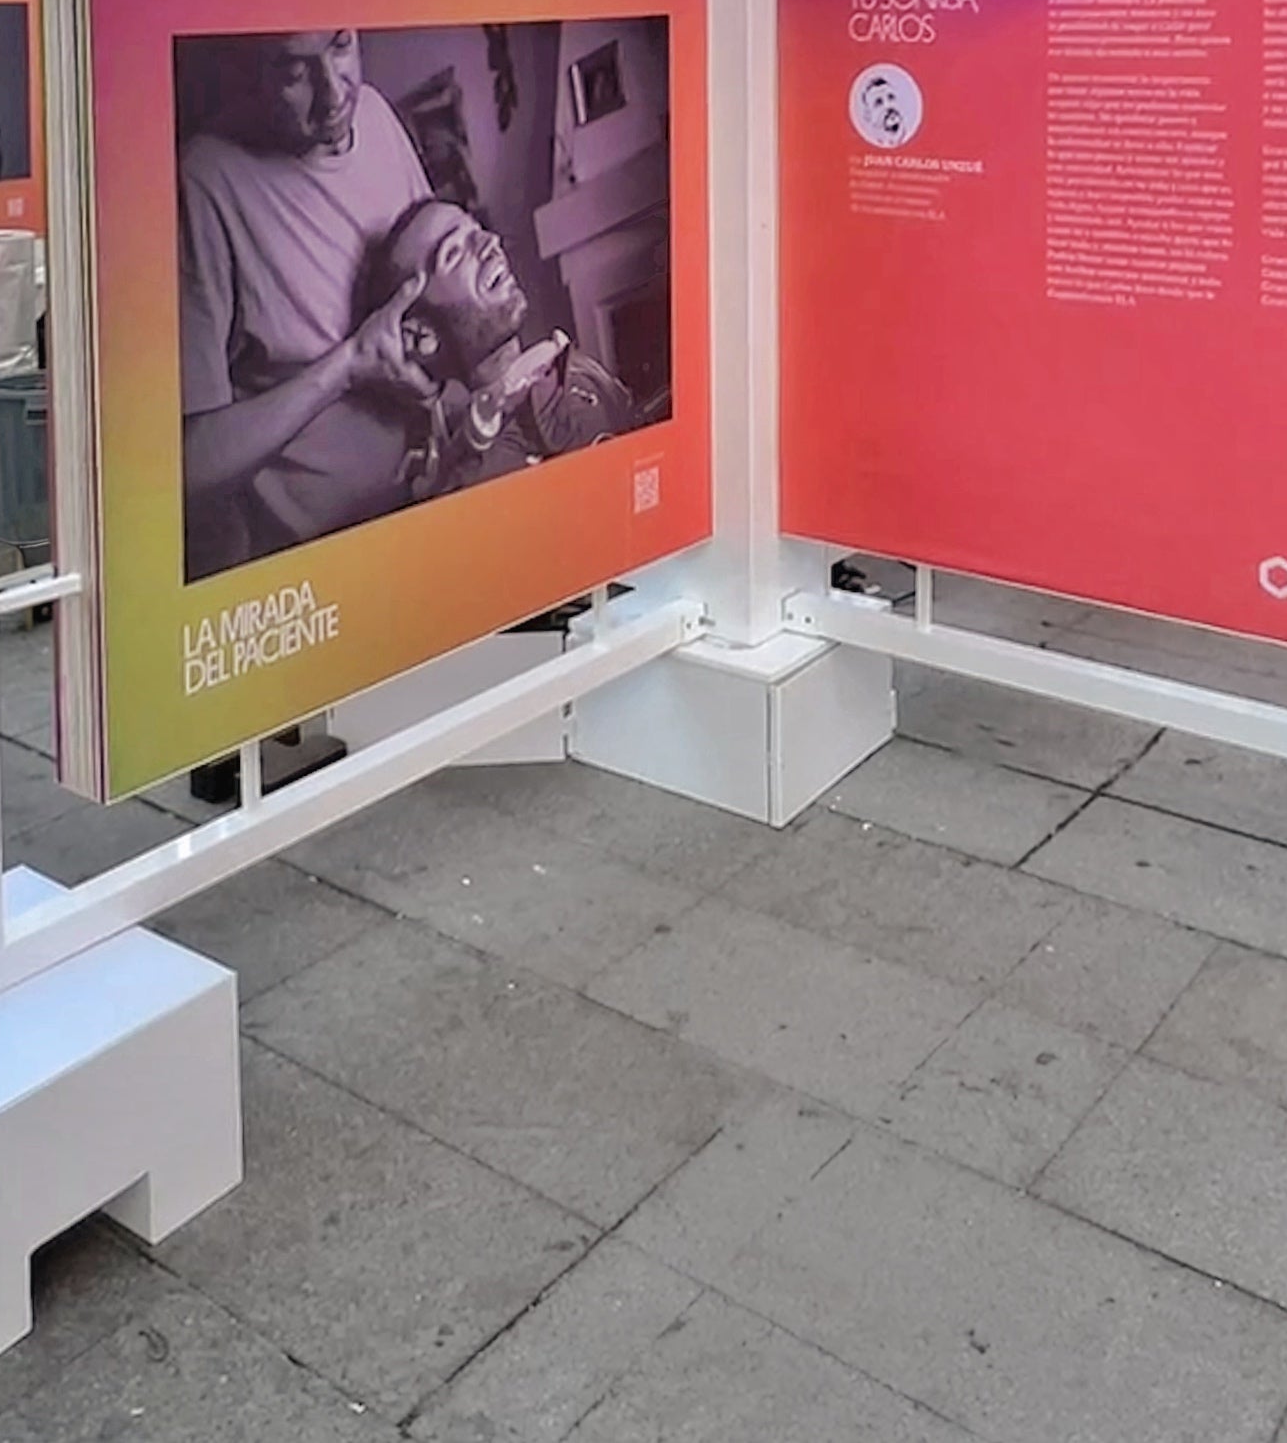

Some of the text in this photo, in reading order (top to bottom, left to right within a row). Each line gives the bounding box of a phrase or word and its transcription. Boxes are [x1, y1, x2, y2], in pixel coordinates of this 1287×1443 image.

[848, 12, 936, 44] CARLOS
[183, 580, 316, 658] LA MIRADA
[185, 603, 340, 696] DEL PACIENTE
